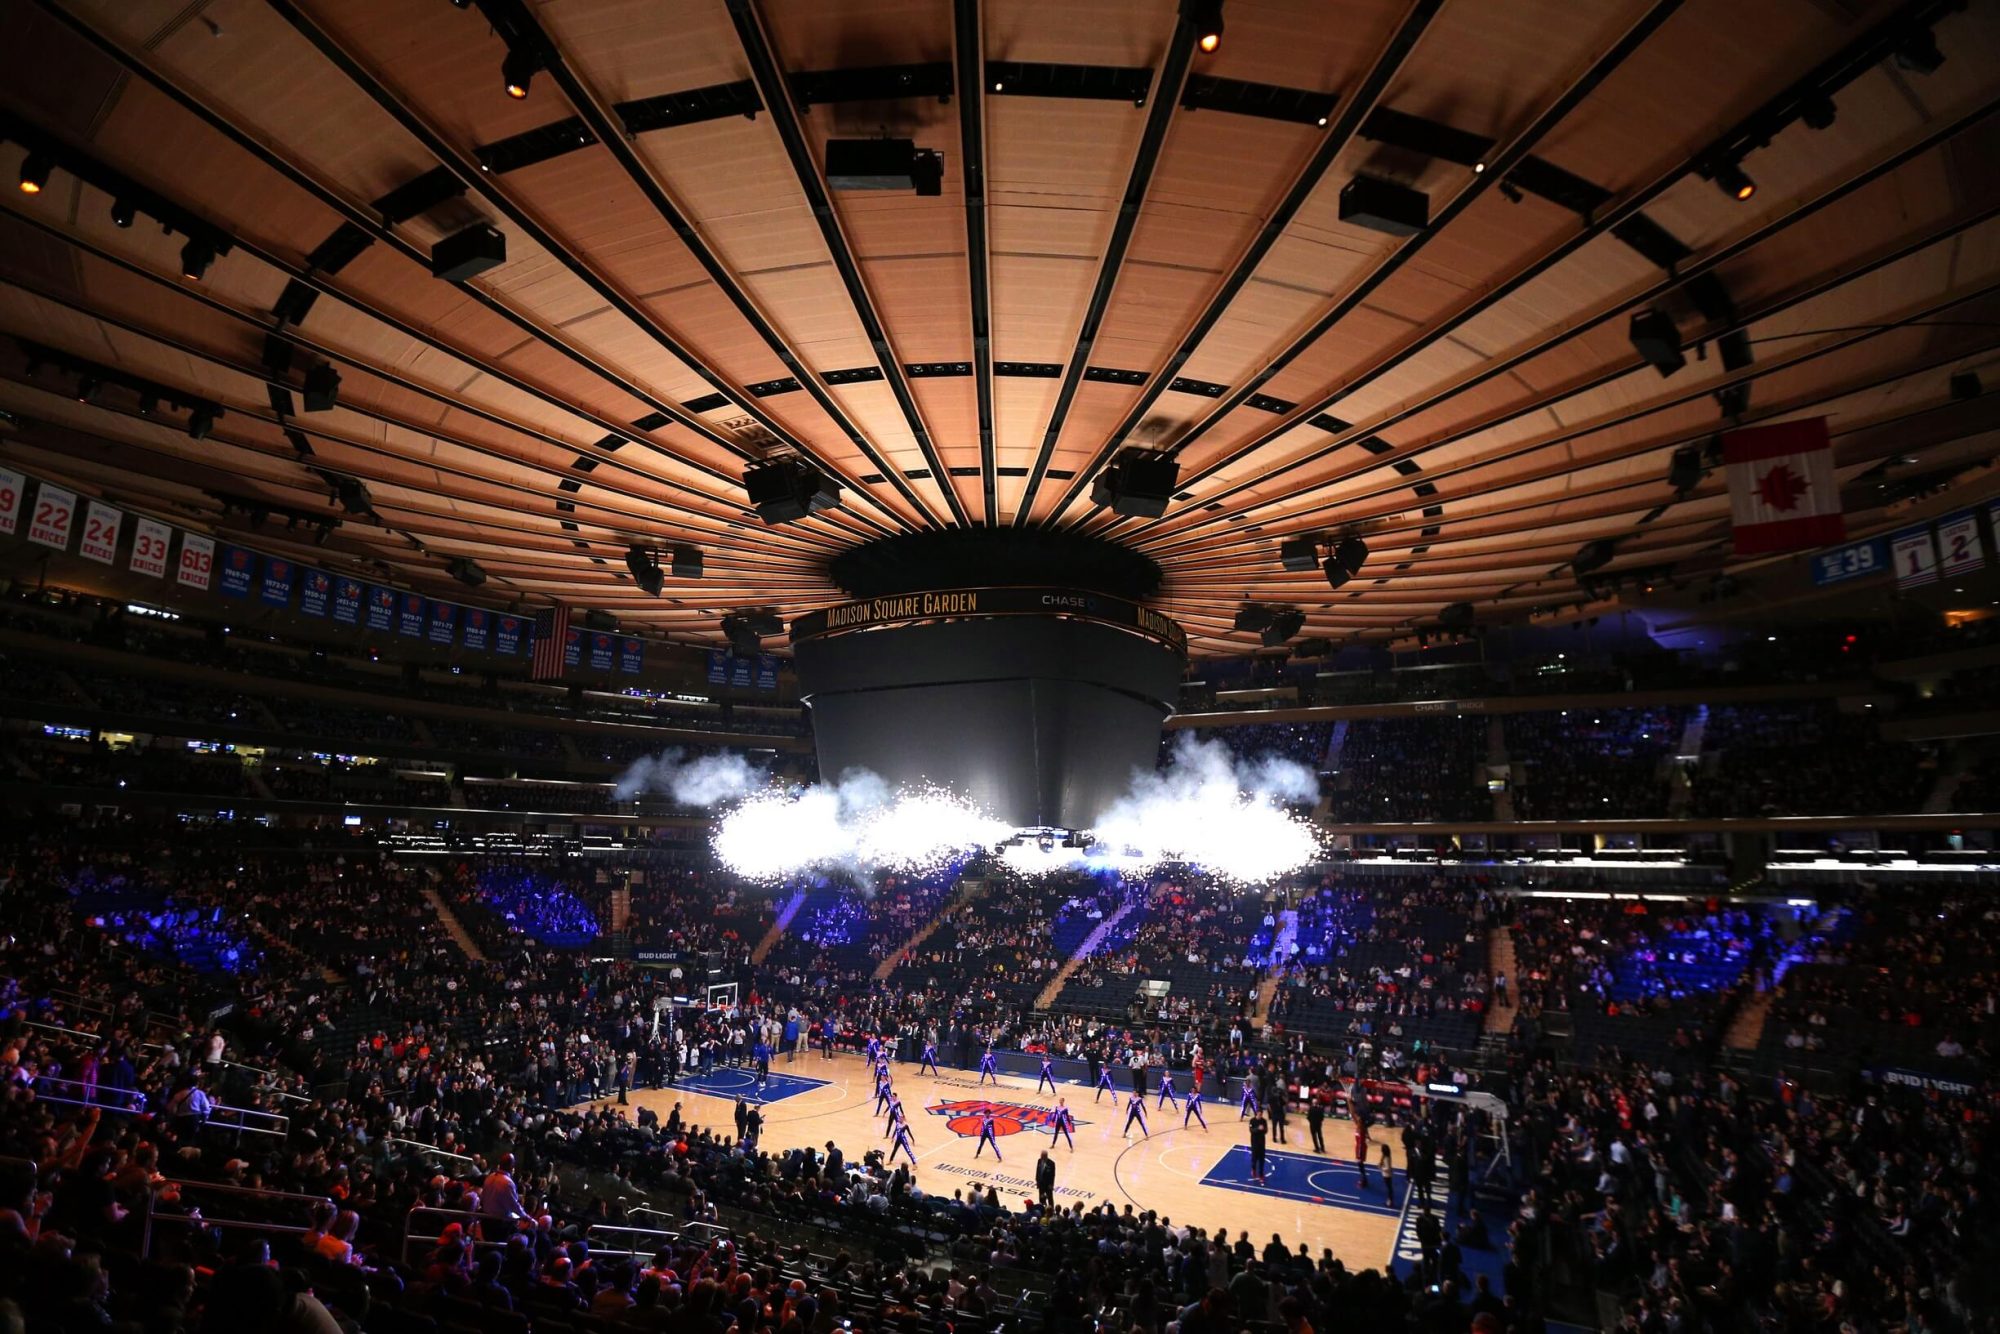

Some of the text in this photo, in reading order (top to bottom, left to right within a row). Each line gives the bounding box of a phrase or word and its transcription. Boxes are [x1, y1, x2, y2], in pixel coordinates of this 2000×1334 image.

[36, 502, 69, 531] 22
[31, 526, 66, 546] KNICKS
[87, 518, 115, 546] 24
[83, 542, 113, 561] KNICKS
[137, 535, 166, 560] 33
[1844, 544, 1874, 572] 39
[1951, 535, 1969, 562] 2
[133, 558, 163, 574] KNICKS
[182, 549, 211, 573] 613
[1909, 550, 1921, 575] 1
[180, 571, 208, 587] KNICKS
[827, 592, 977, 628] MADISON SQUARE GARDEN
[1042, 595, 1086, 608] CHASE
[1137, 606, 1168, 637] MADISON
[638, 952, 677, 960] BUD LIGHT
[1886, 1071, 1921, 1087] BUD
[933, 1162, 991, 1179] MADISON
[1052, 1185, 1096, 1200] ARDEN
